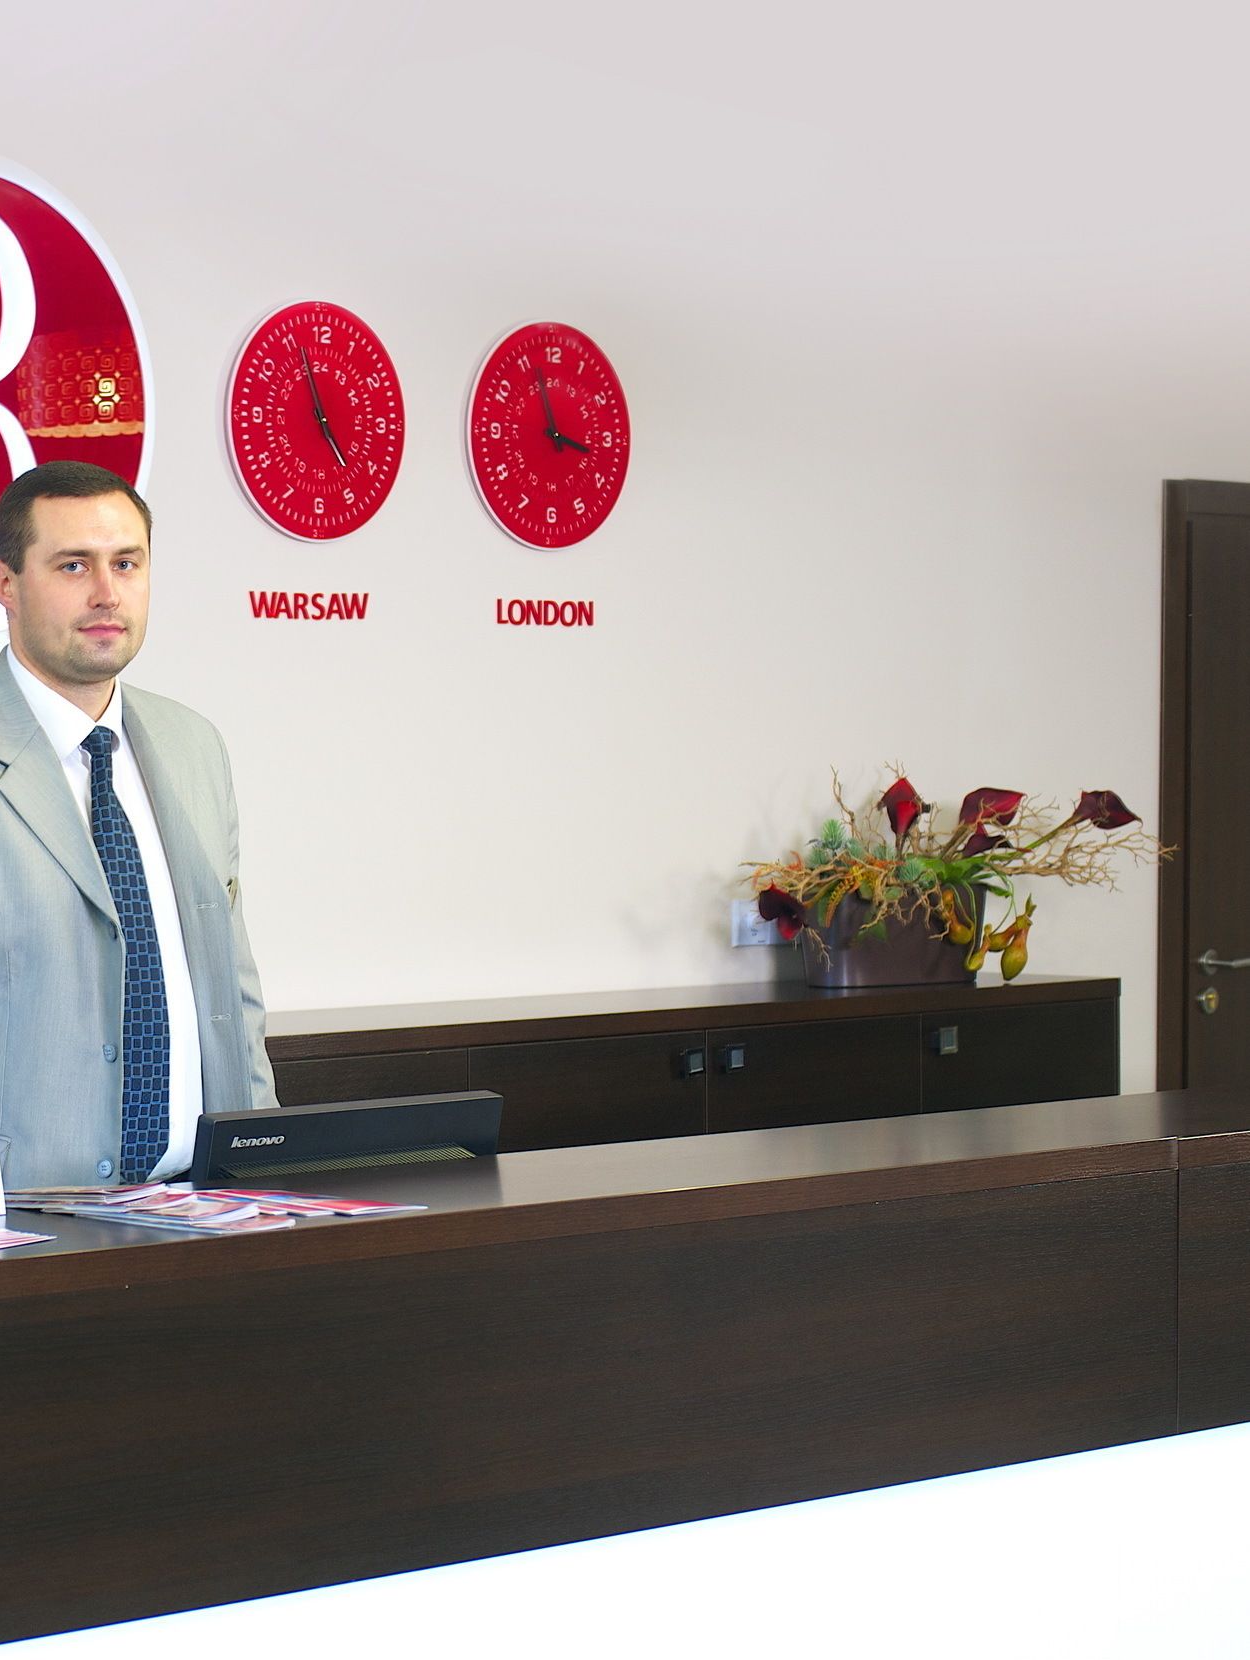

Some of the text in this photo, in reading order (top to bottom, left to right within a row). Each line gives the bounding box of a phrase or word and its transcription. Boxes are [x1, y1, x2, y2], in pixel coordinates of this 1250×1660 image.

[282, 334, 298, 351] 11
[312, 327, 332, 344] 12
[347, 342, 355, 354] 1
[545, 347, 562, 363] 12
[259, 359, 275, 382] 10
[518, 356, 530, 372] 11
[577, 361, 585, 374] 1
[366, 373, 380, 390] 2
[495, 380, 510, 404] 10
[594, 392, 606, 407] 2
[253, 407, 262, 423] 9
[375, 418, 386, 432] 3
[490, 423, 501, 439] 9
[603, 432, 612, 447] 3
[258, 452, 271, 468] 8
[367, 462, 378, 474] 4
[496, 464, 509, 480] 8
[595, 473, 605, 488] 4
[282, 485, 294, 499] 7
[343, 488, 355, 504] 5
[314, 498, 324, 513] 6
[517, 494, 529, 508] 7
[573, 498, 585, 514] 5
[546, 507, 557, 523] 6
[249, 590, 369, 620] WARSAW
[496, 598, 594, 626] LONDON
[230, 1134, 285, 1149] lenovo
